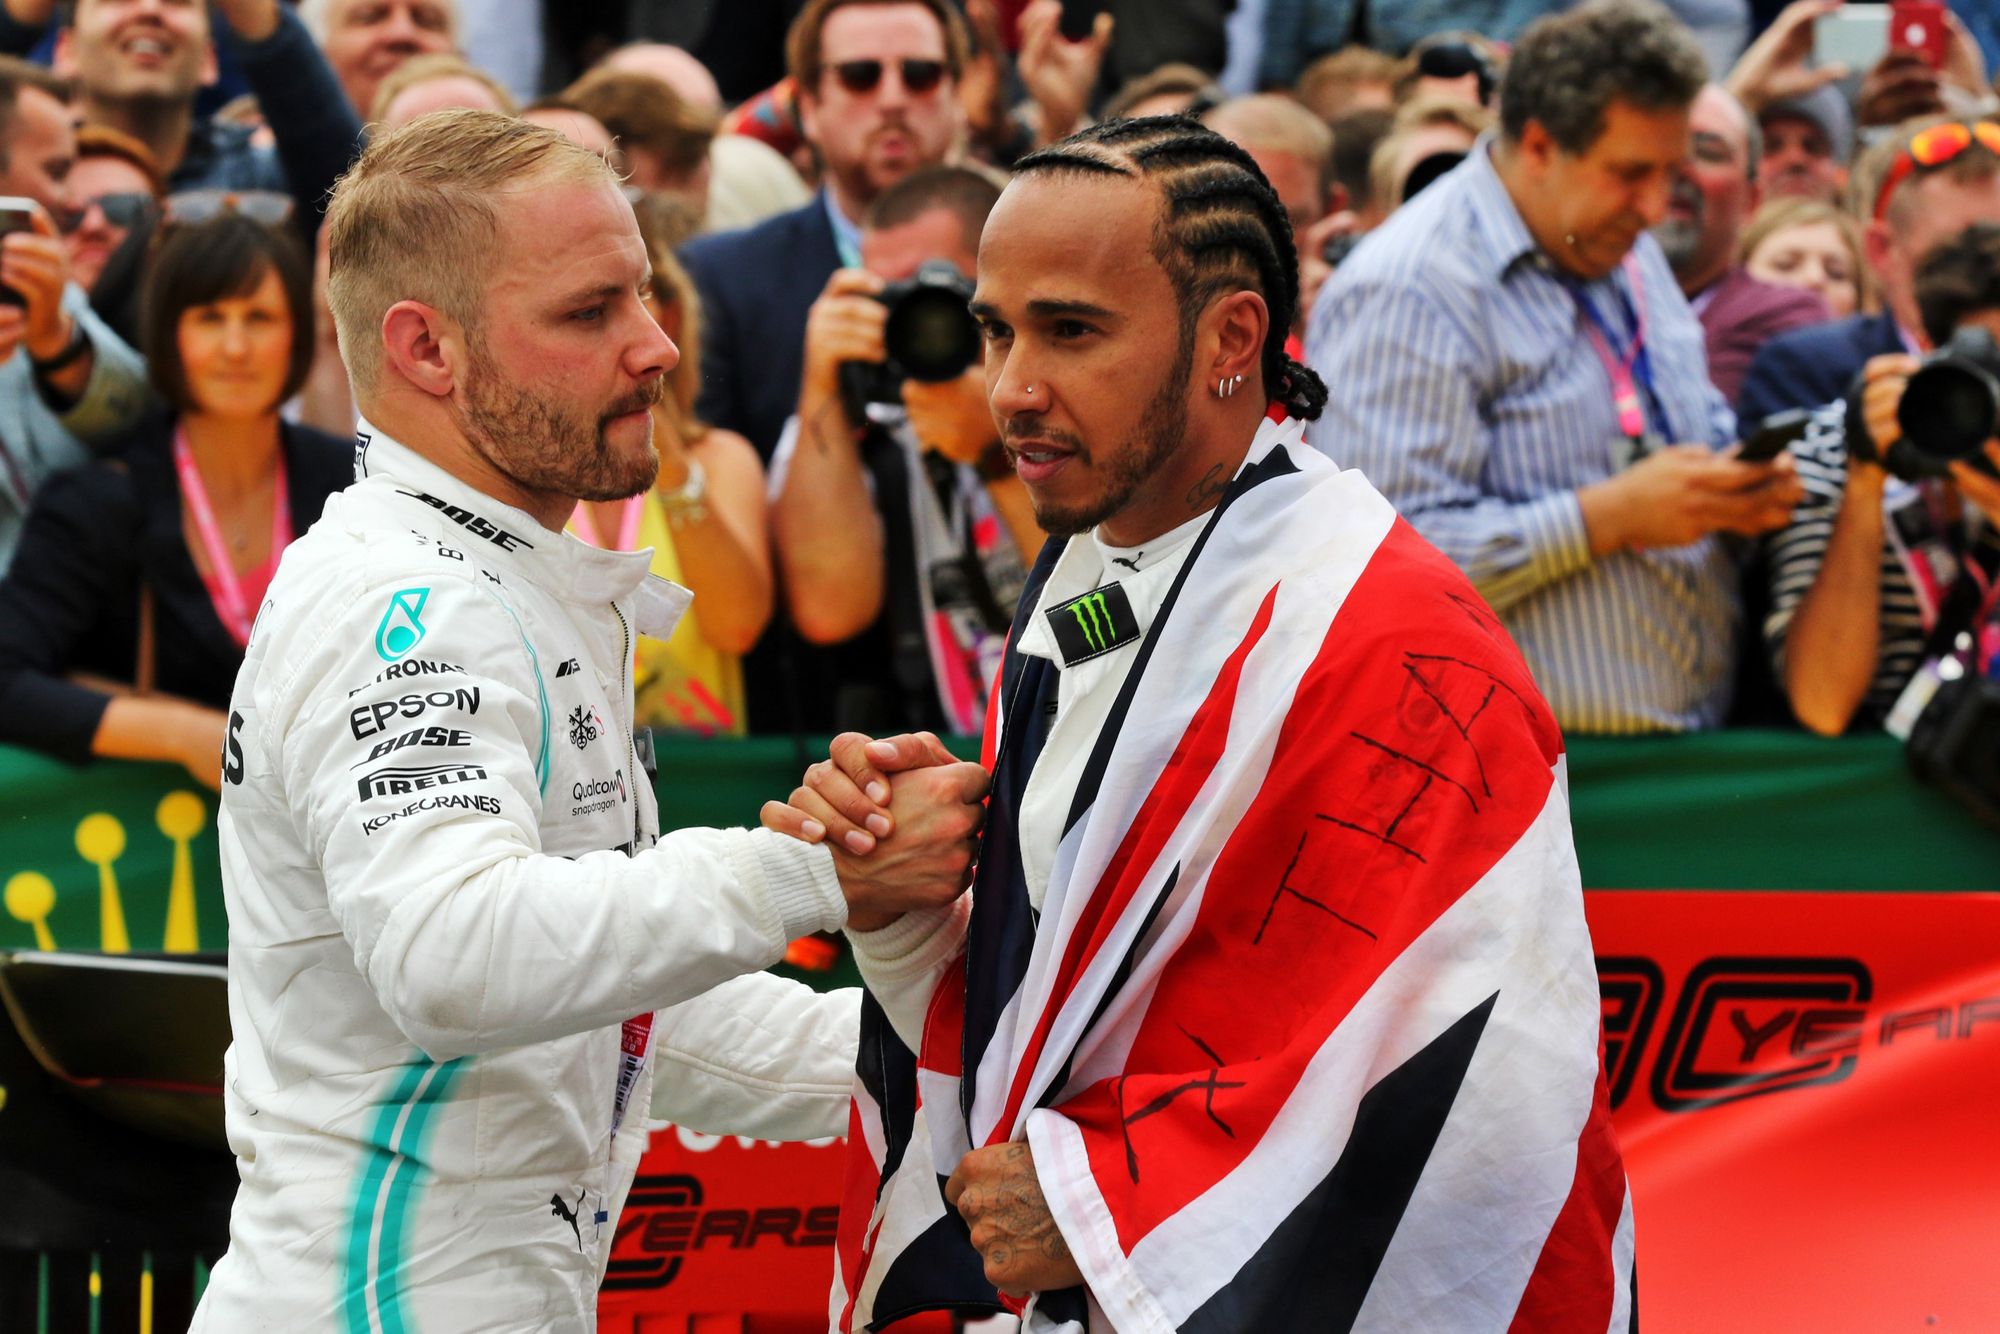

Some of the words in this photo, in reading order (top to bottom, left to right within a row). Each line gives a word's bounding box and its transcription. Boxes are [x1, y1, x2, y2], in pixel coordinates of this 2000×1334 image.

[396, 490, 534, 552] BOSE
[349, 659, 468, 698] RONA
[350, 686, 480, 741] EPSON
[352, 726, 477, 768] BOSE
[357, 764, 487, 803] PIRELLI
[572, 778, 618, 802] Qualcom
[362, 794, 501, 836] KONECRANES
[571, 799, 616, 816] snapdragon
